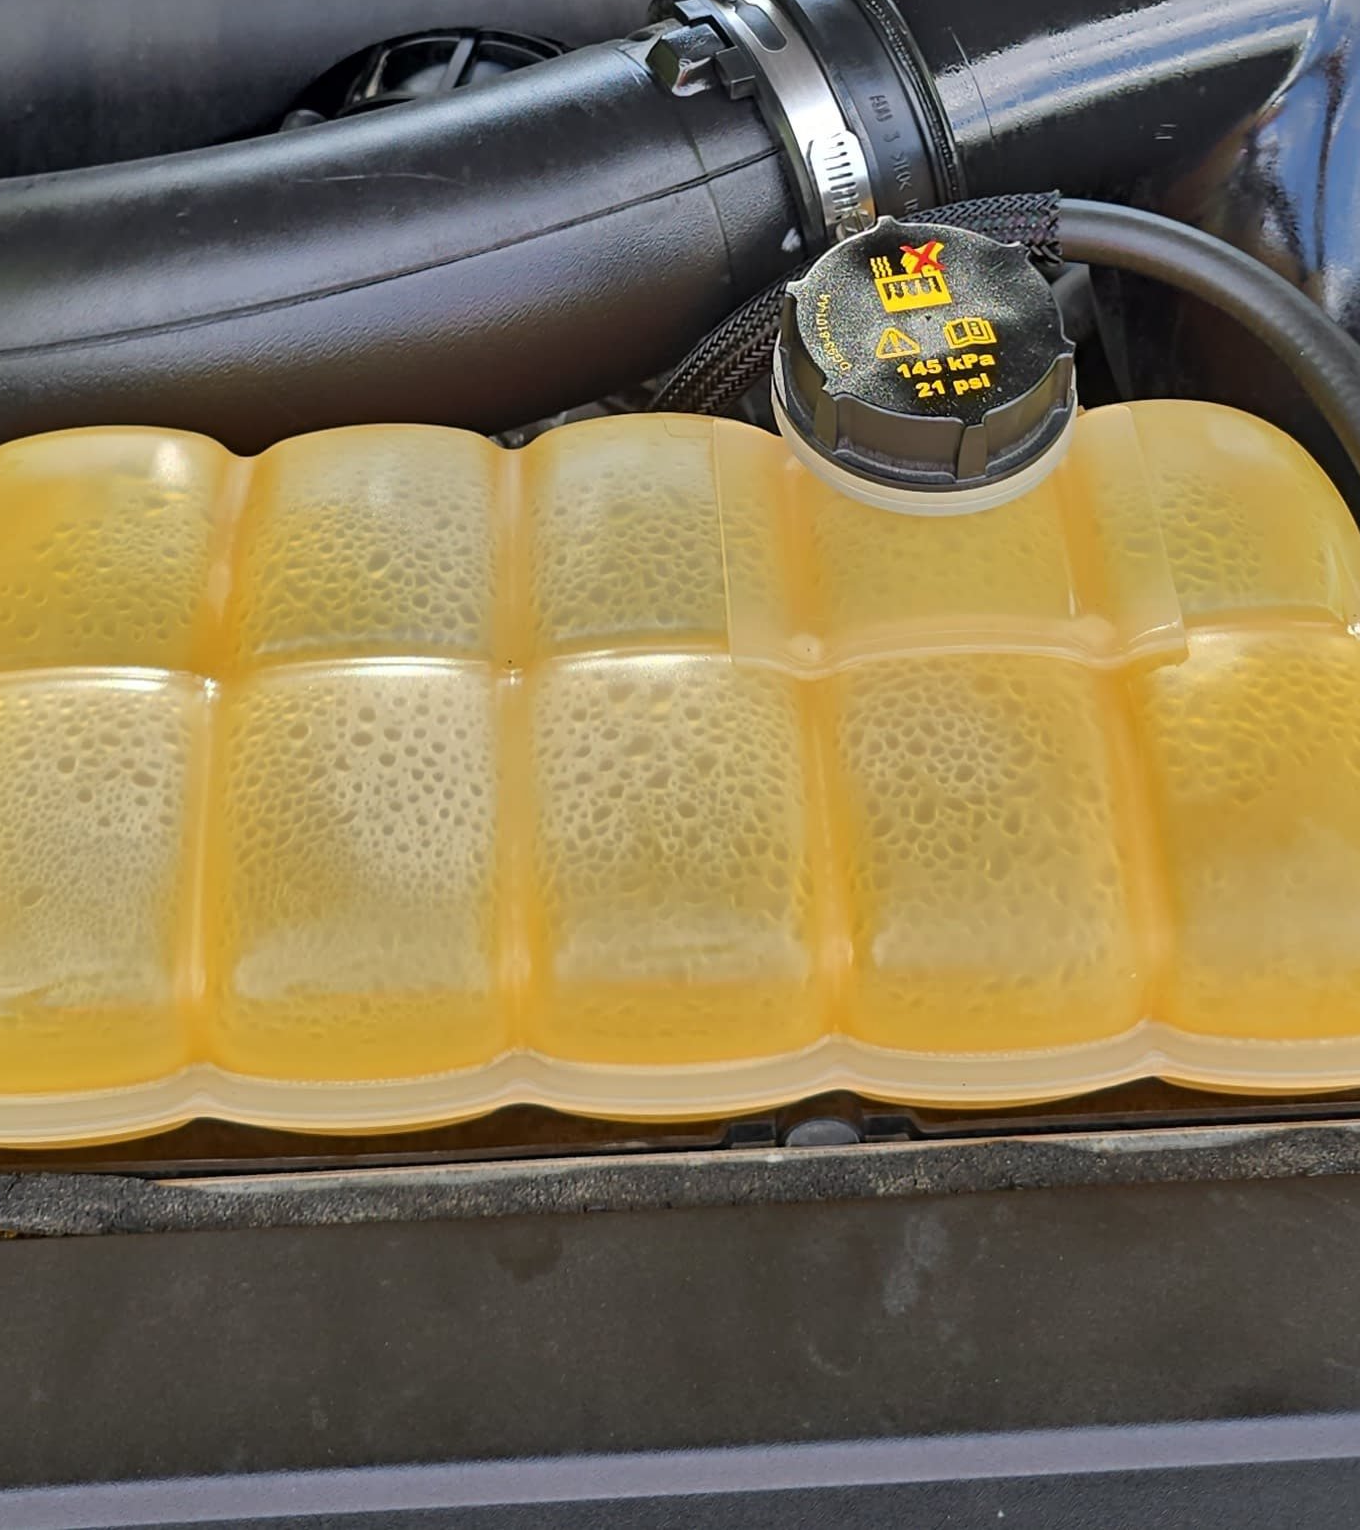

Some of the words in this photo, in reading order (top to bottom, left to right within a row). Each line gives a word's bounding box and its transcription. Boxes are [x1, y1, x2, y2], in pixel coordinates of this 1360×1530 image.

[896, 359, 942, 379] 145
[949, 352, 996, 372] kPa
[915, 380, 946, 398] 21
